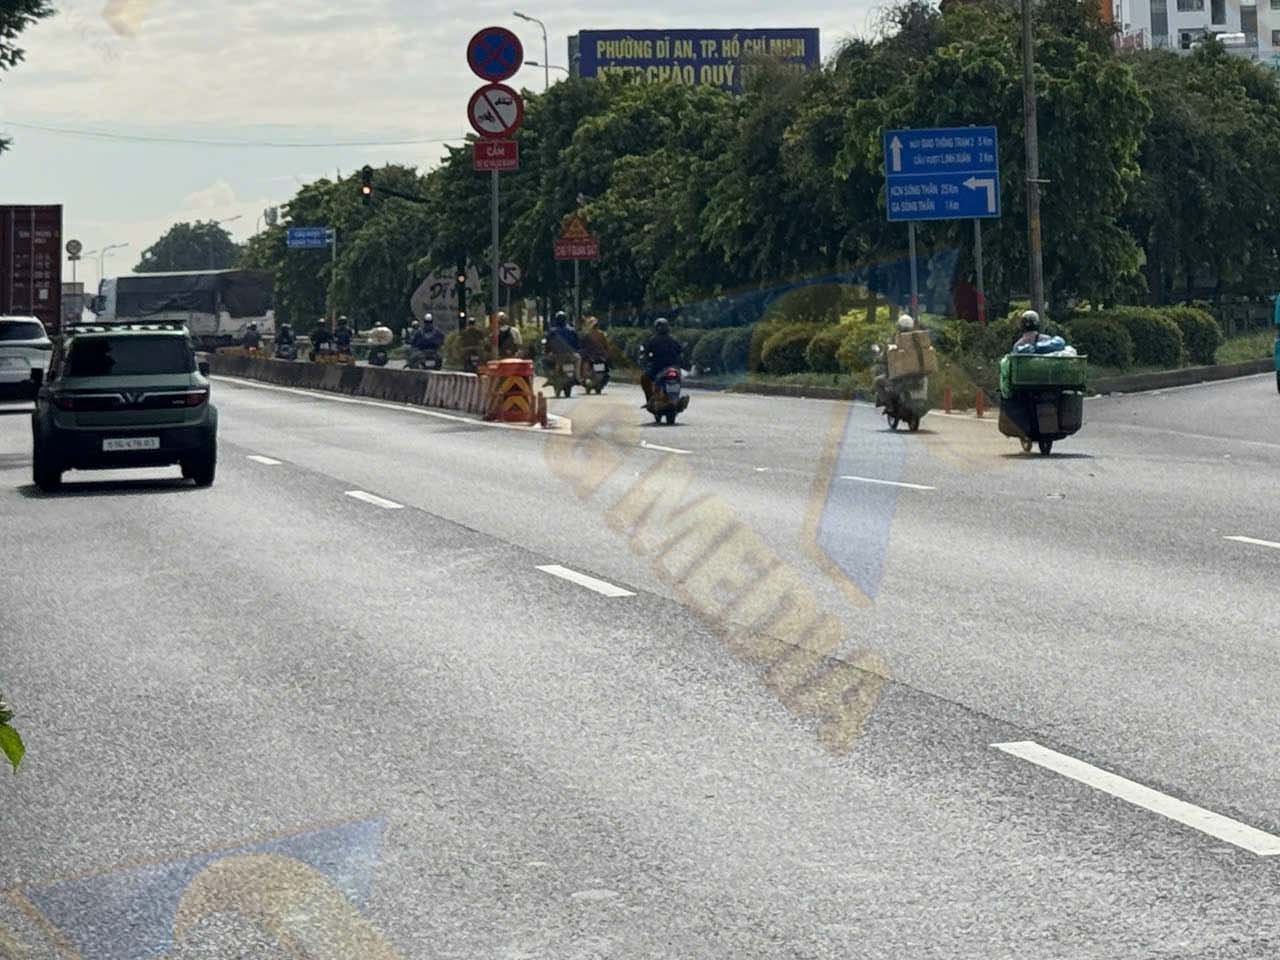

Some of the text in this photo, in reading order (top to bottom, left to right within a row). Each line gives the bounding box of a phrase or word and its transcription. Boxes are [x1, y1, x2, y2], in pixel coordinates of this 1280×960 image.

[596, 35, 652, 59] PHƯỜNG
[673, 40, 697, 60] AN,
[700, 39, 719, 58] TP.
